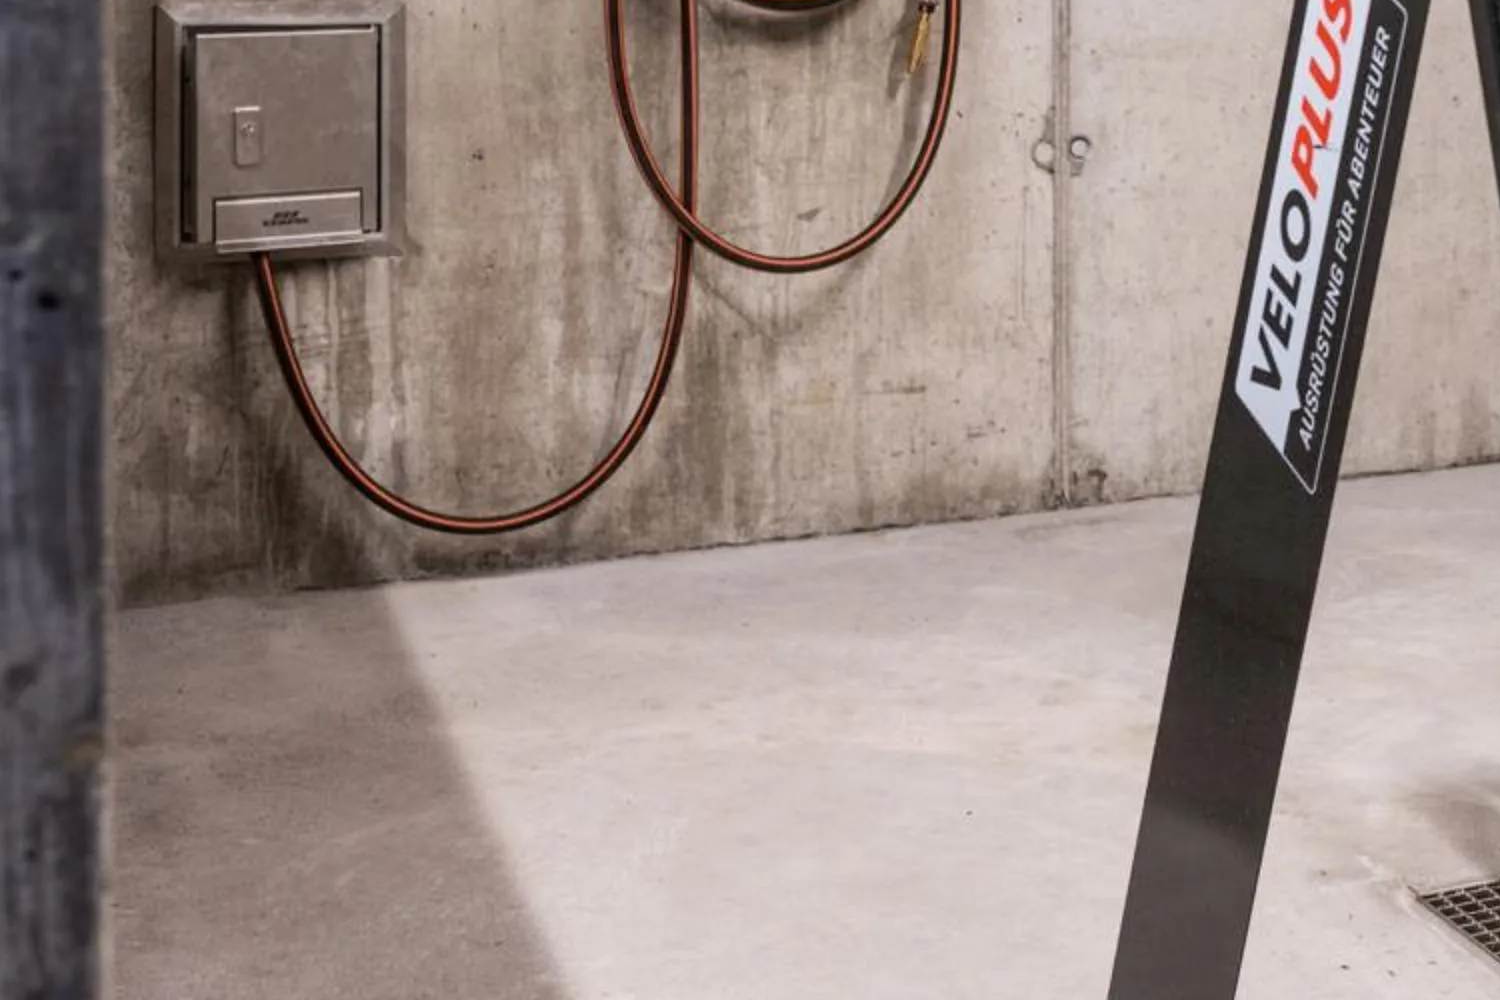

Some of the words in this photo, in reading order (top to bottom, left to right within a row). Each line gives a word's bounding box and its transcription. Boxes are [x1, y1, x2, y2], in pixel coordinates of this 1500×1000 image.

[1299, 263, 1345, 451] AUSRÜSTUNG
[1334, 200, 1357, 262] FÜR
[1347, 24, 1391, 201] ABENTEUER
